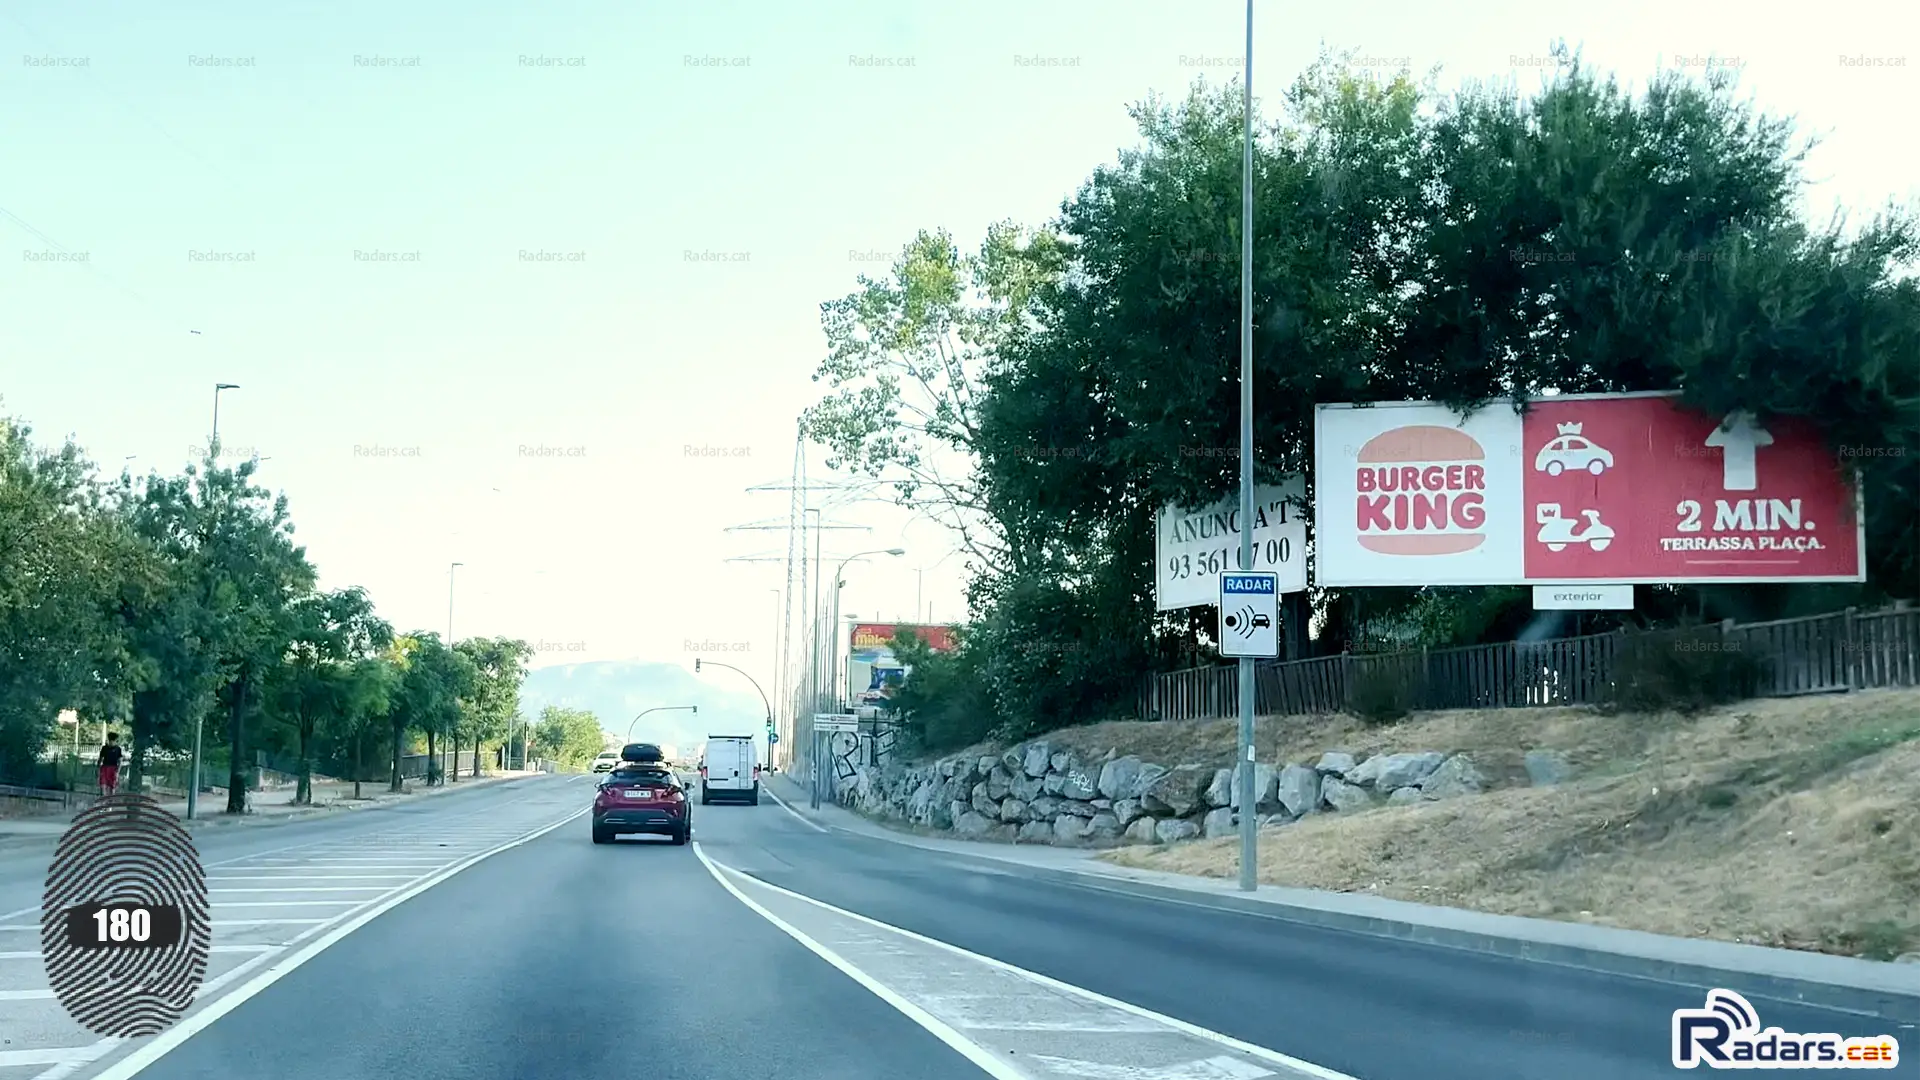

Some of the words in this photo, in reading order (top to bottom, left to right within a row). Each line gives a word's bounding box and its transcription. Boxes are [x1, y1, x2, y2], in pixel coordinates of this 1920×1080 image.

[1357, 465, 1485, 492] BURGER
[1170, 500, 1289, 544] ANUNCA'T
[1357, 492, 1486, 531] KING
[1676, 500, 1701, 532] 2
[1712, 499, 1816, 531] MIN.
[1169, 554, 1191, 580] 93
[1197, 548, 1228, 576] 561
[1266, 537, 1290, 565] 00
[1660, 537, 1755, 551] TERRASSA
[1758, 537, 1826, 553] PLAÇA.
[1226, 579, 1273, 590] RADAR
[1554, 592, 1604, 601] exterior
